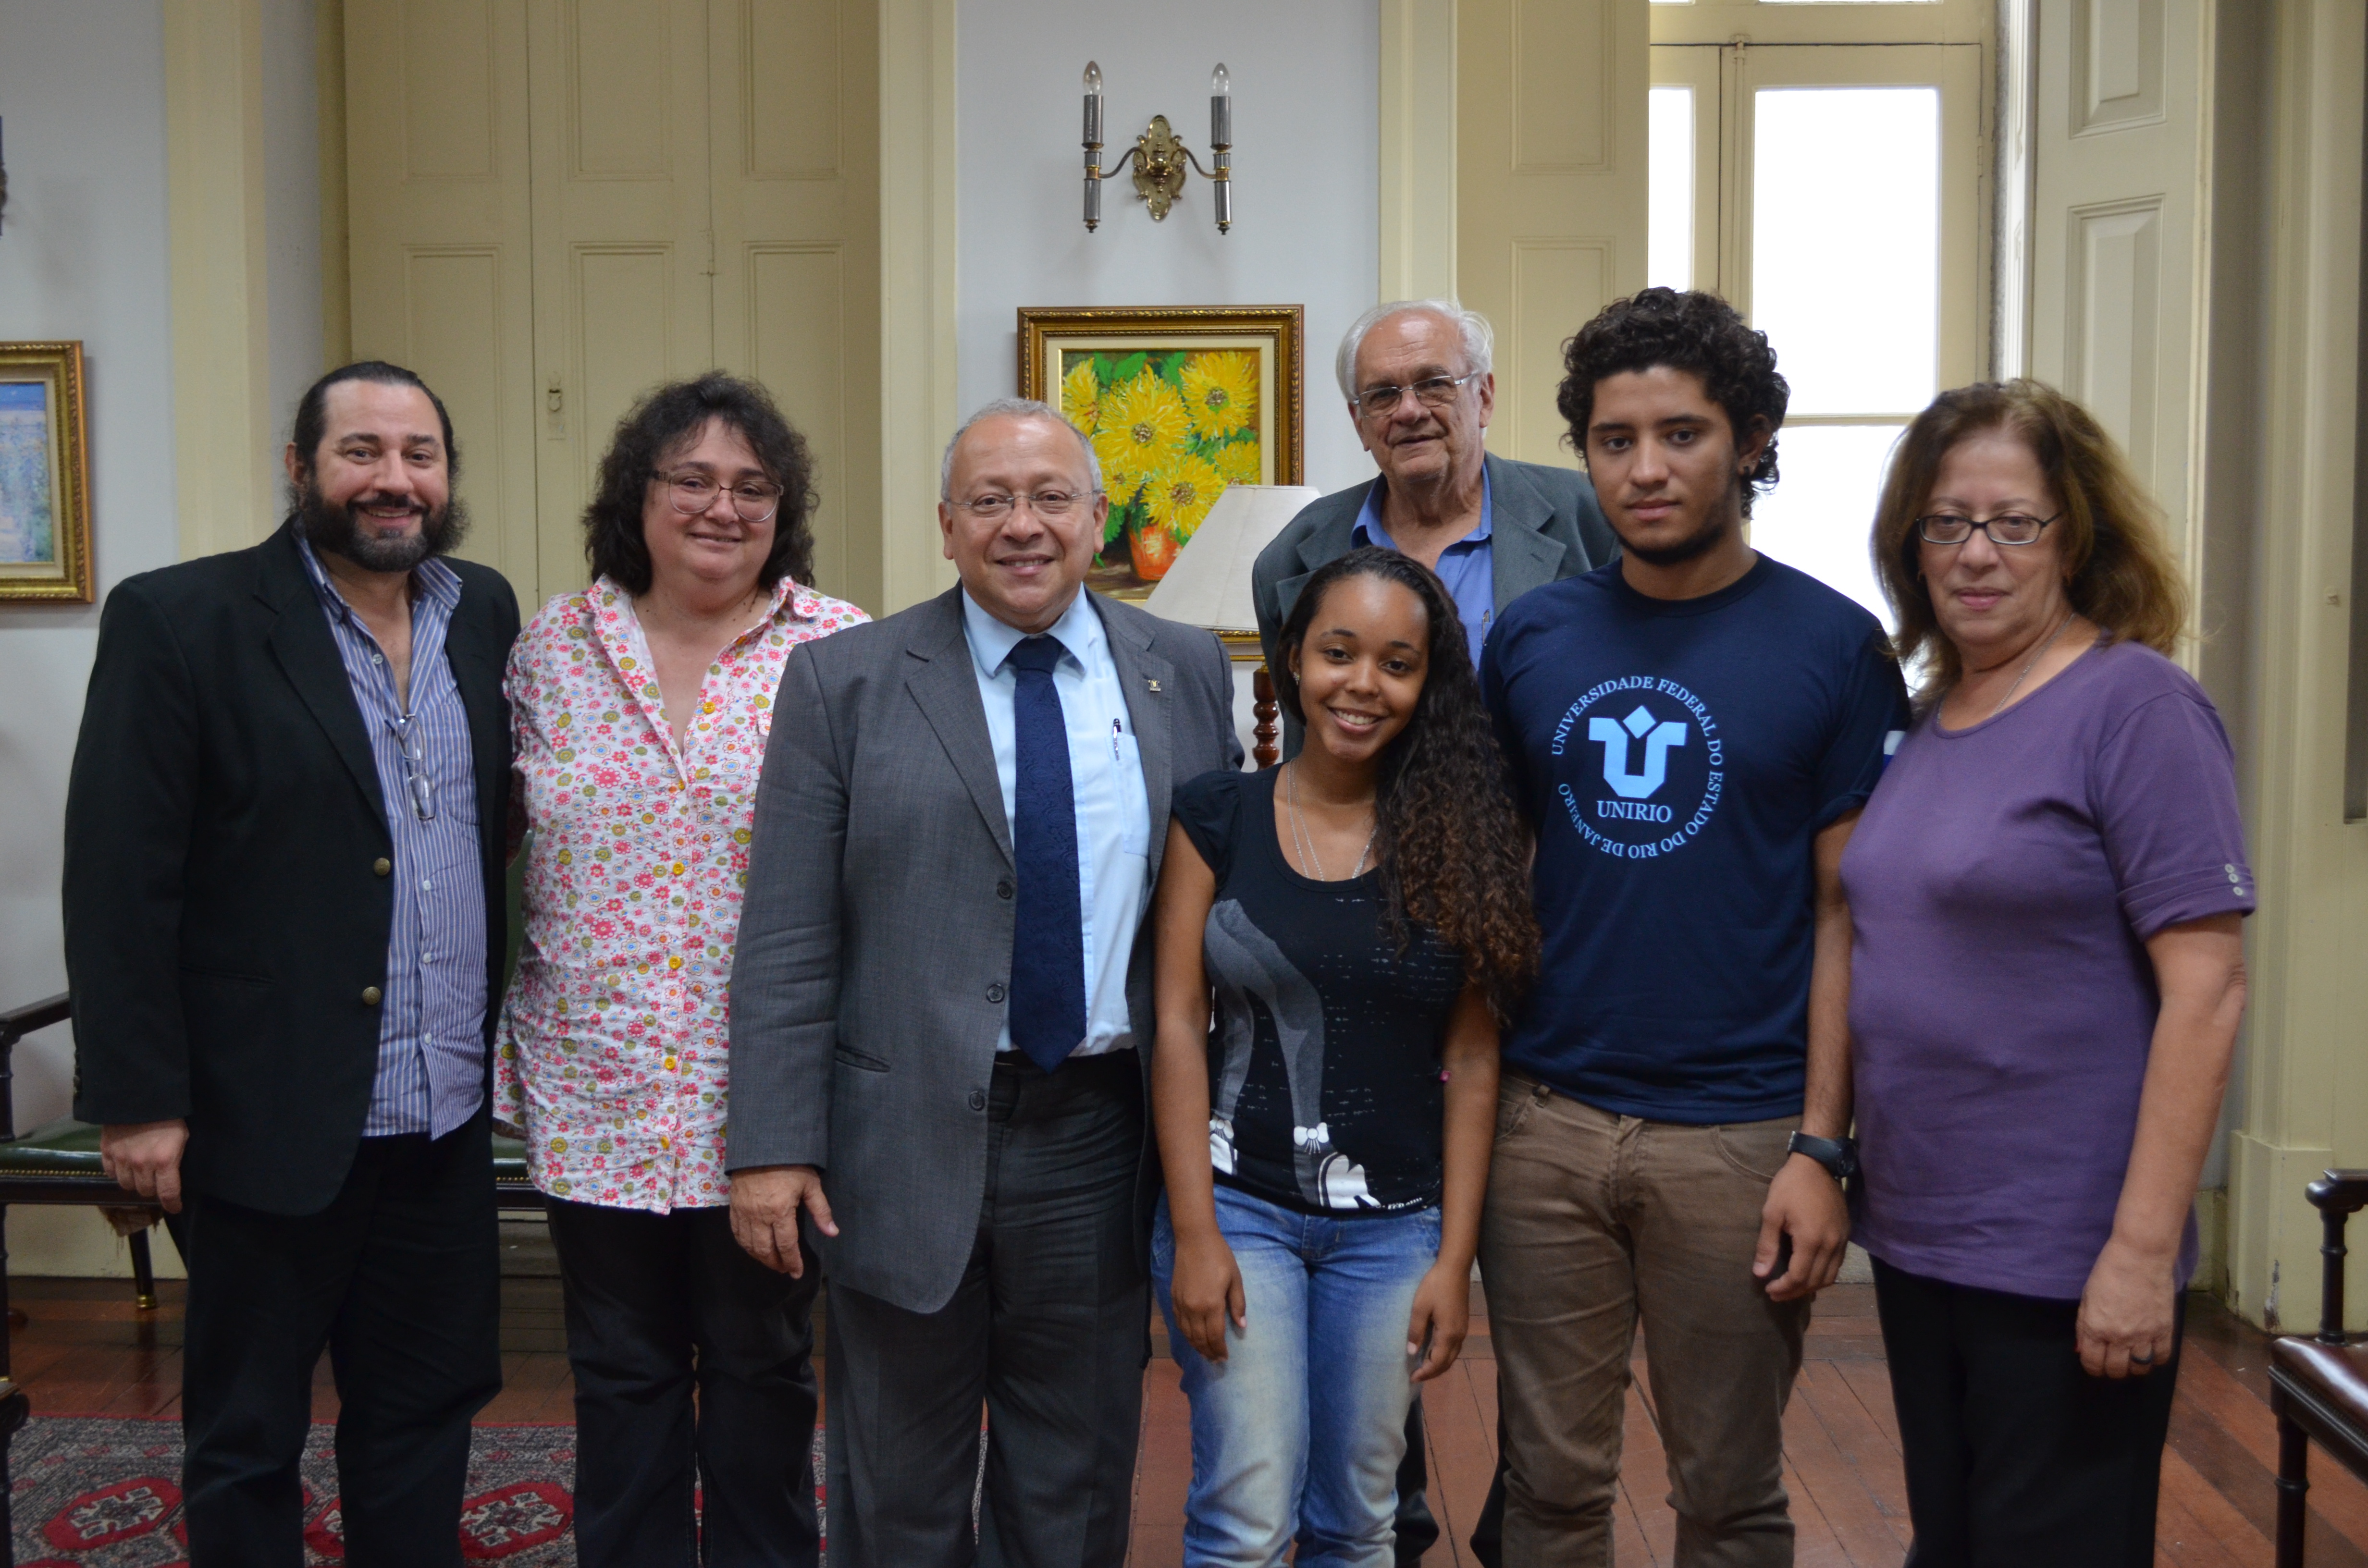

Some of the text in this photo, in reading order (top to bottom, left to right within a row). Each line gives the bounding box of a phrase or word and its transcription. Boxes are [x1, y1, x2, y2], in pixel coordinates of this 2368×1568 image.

[1552, 675, 1724, 859] UNIVERSIDADE FEDERAL DO ESTADO DO RIO DE JANEIRO
[1596, 800, 1673, 823] UNIRIO
